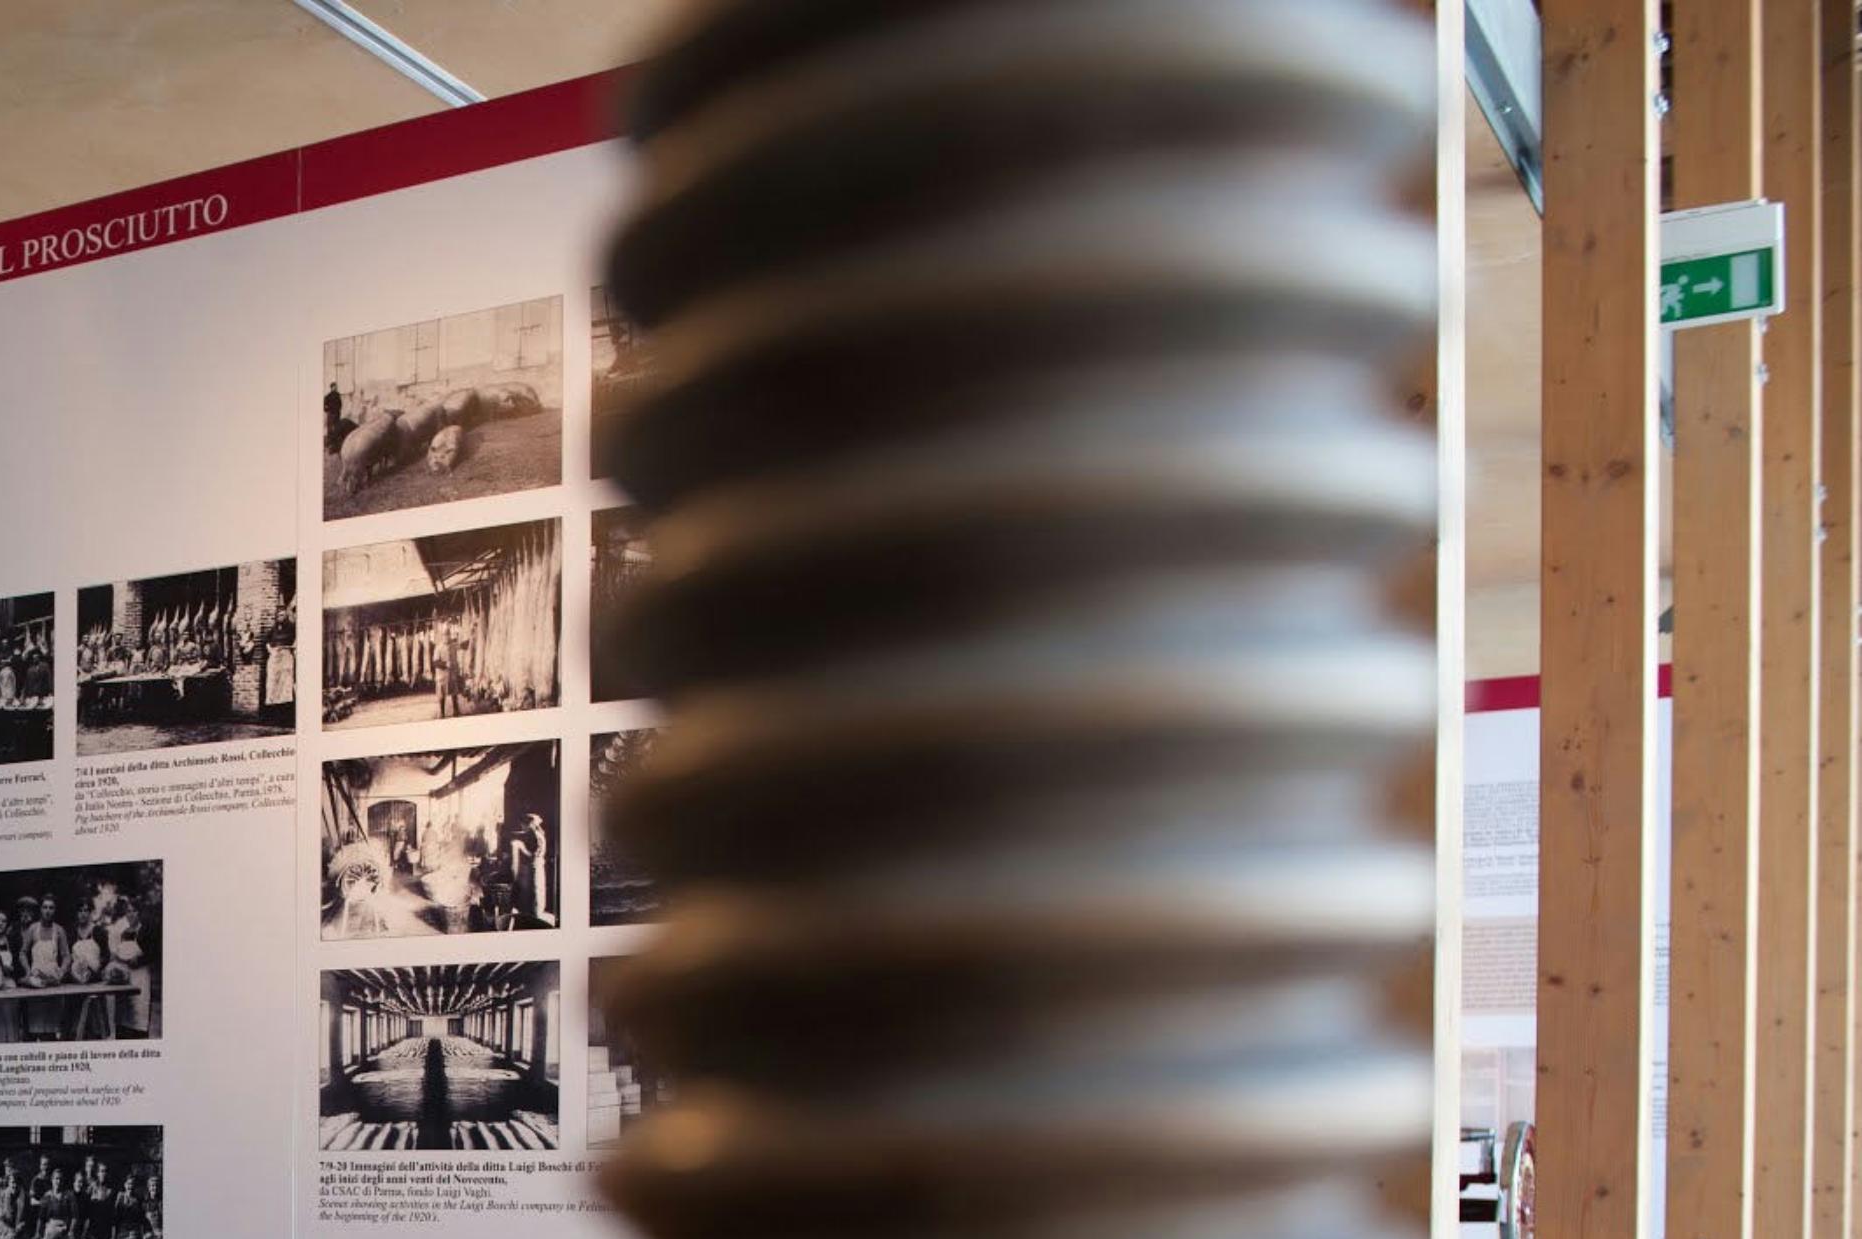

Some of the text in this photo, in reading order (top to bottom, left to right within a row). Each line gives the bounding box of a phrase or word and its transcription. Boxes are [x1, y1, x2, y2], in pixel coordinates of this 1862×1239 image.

[22, 193, 228, 269] PROSCIUTTO
[320, 1162, 348, 1172] 7/9-20
[350, 1162, 396, 1174] Immagini
[456, 1162, 480, 1172] della
[483, 1162, 506, 1172] ditta
[509, 1162, 536, 1174] Luigi
[538, 1162, 572, 1172] Boschi
[575, 1162, 586, 1172] di
